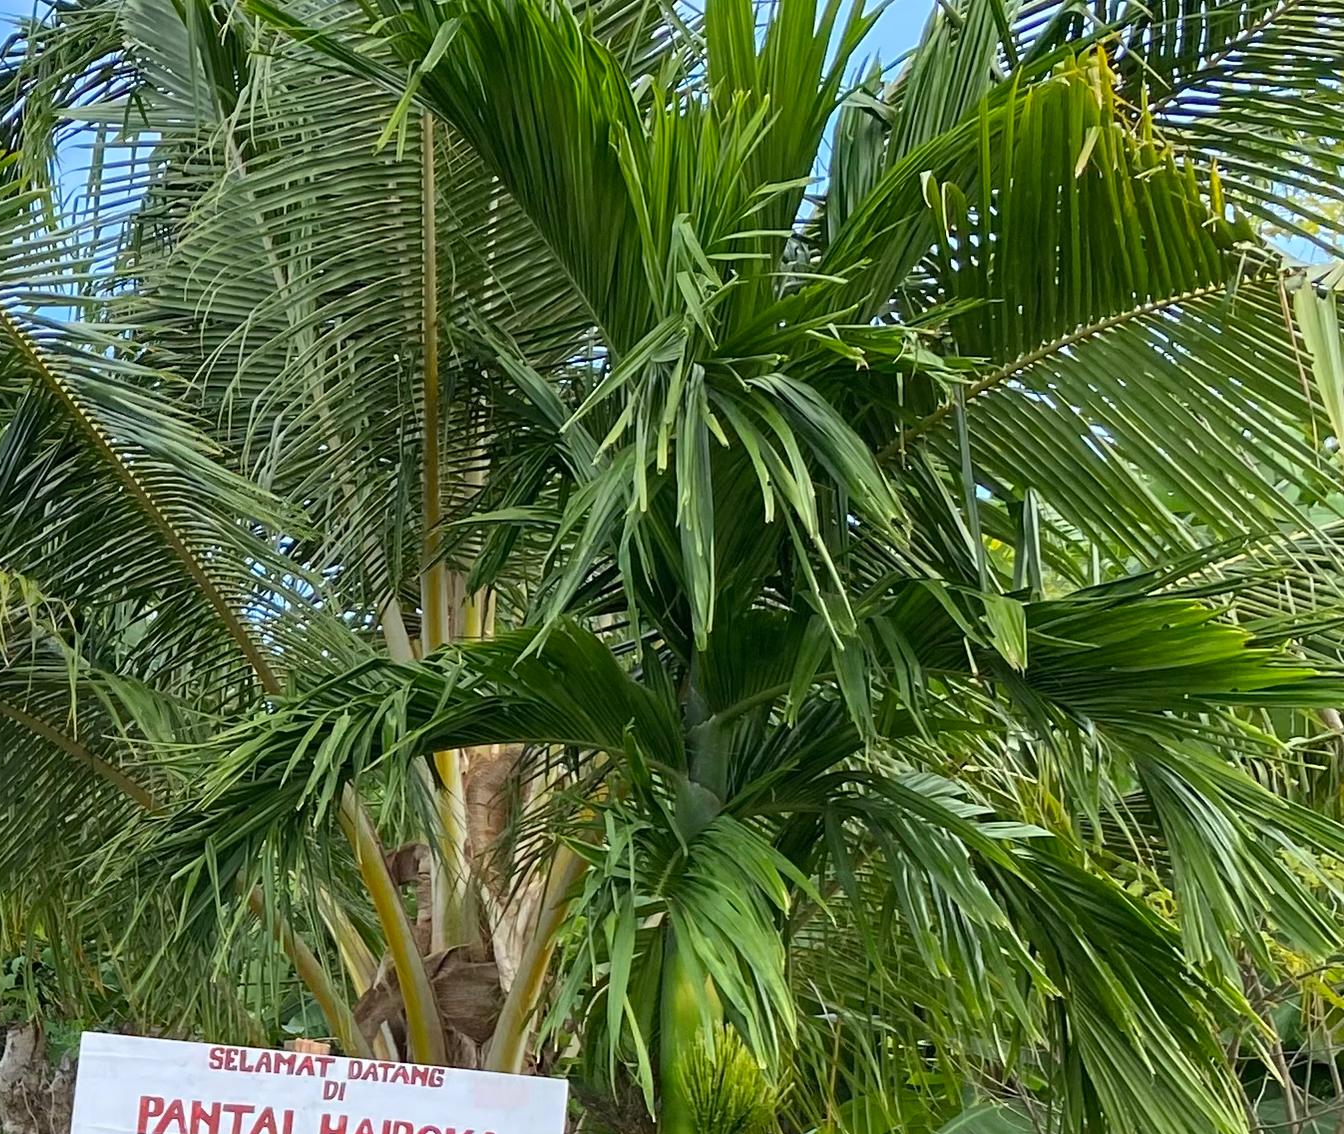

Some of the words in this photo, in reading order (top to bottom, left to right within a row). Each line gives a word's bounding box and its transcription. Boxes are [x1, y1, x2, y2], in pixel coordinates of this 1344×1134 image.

[209, 1047, 335, 1078] SELAMAT
[347, 1060, 445, 1088] DATANG
[323, 1080, 344, 1101] DI
